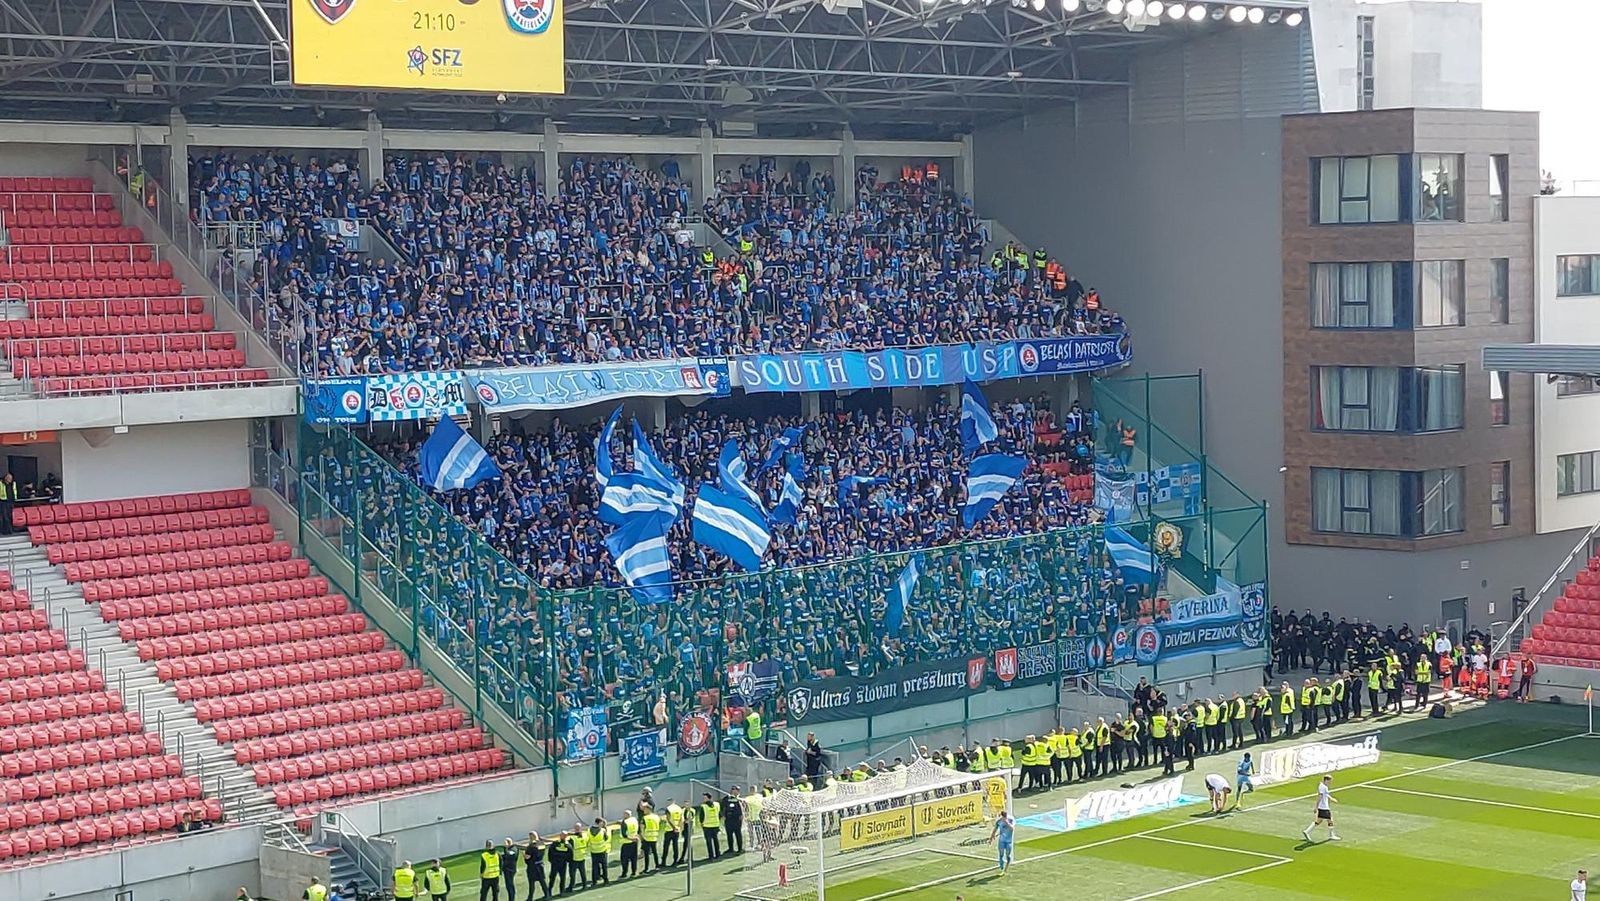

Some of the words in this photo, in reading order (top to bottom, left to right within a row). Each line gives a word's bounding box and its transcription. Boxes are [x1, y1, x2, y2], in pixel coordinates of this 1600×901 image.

[413, 11, 455, 31] 21:10
[432, 48, 462, 66] SFZ
[742, 358, 849, 386] SOUTH
[867, 352, 941, 382] SIDE
[963, 348, 1016, 376] USP
[1018, 652, 1087, 680] PRESSURG
[812, 687, 852, 710] ultras
[855, 681, 898, 704] slovan
[903, 669, 967, 697] pressburg
[936, 800, 975, 820] Slovnaft
[866, 815, 906, 834] Slovnaft
